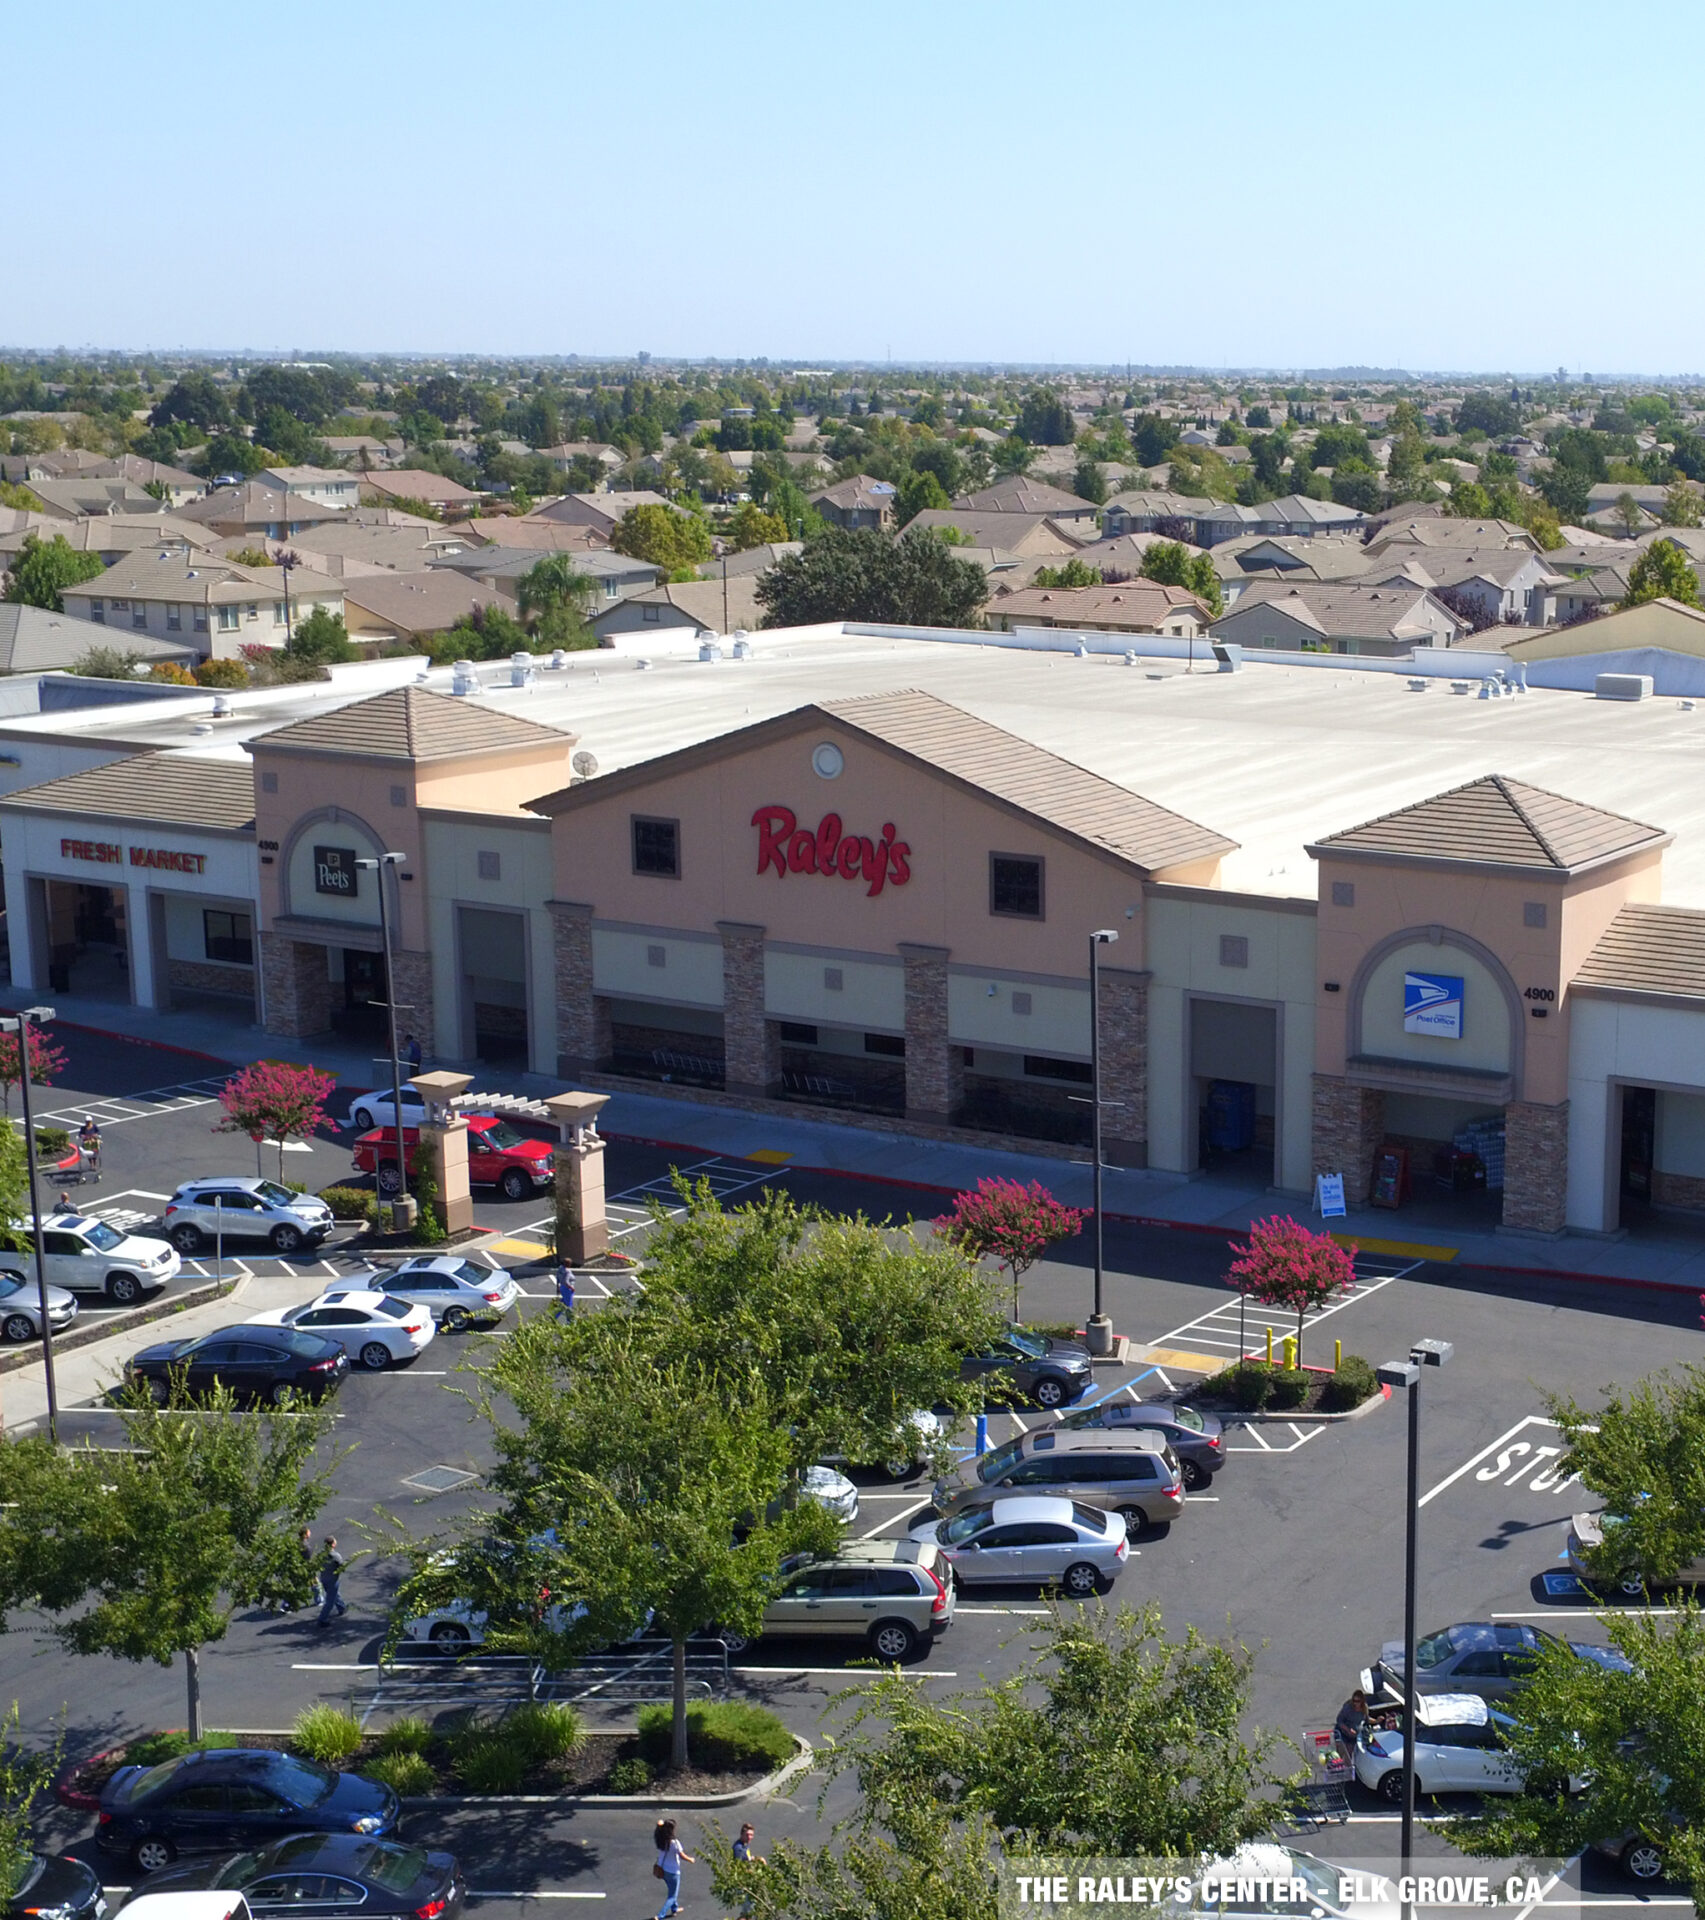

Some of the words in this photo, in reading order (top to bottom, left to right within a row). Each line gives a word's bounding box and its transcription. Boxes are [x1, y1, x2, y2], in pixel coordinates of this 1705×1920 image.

[60, 838, 122, 864] FRESH
[129, 846, 207, 874] MARKET
[751, 805, 911, 897] Raley's
[1523, 986, 1555, 1002] 4900
